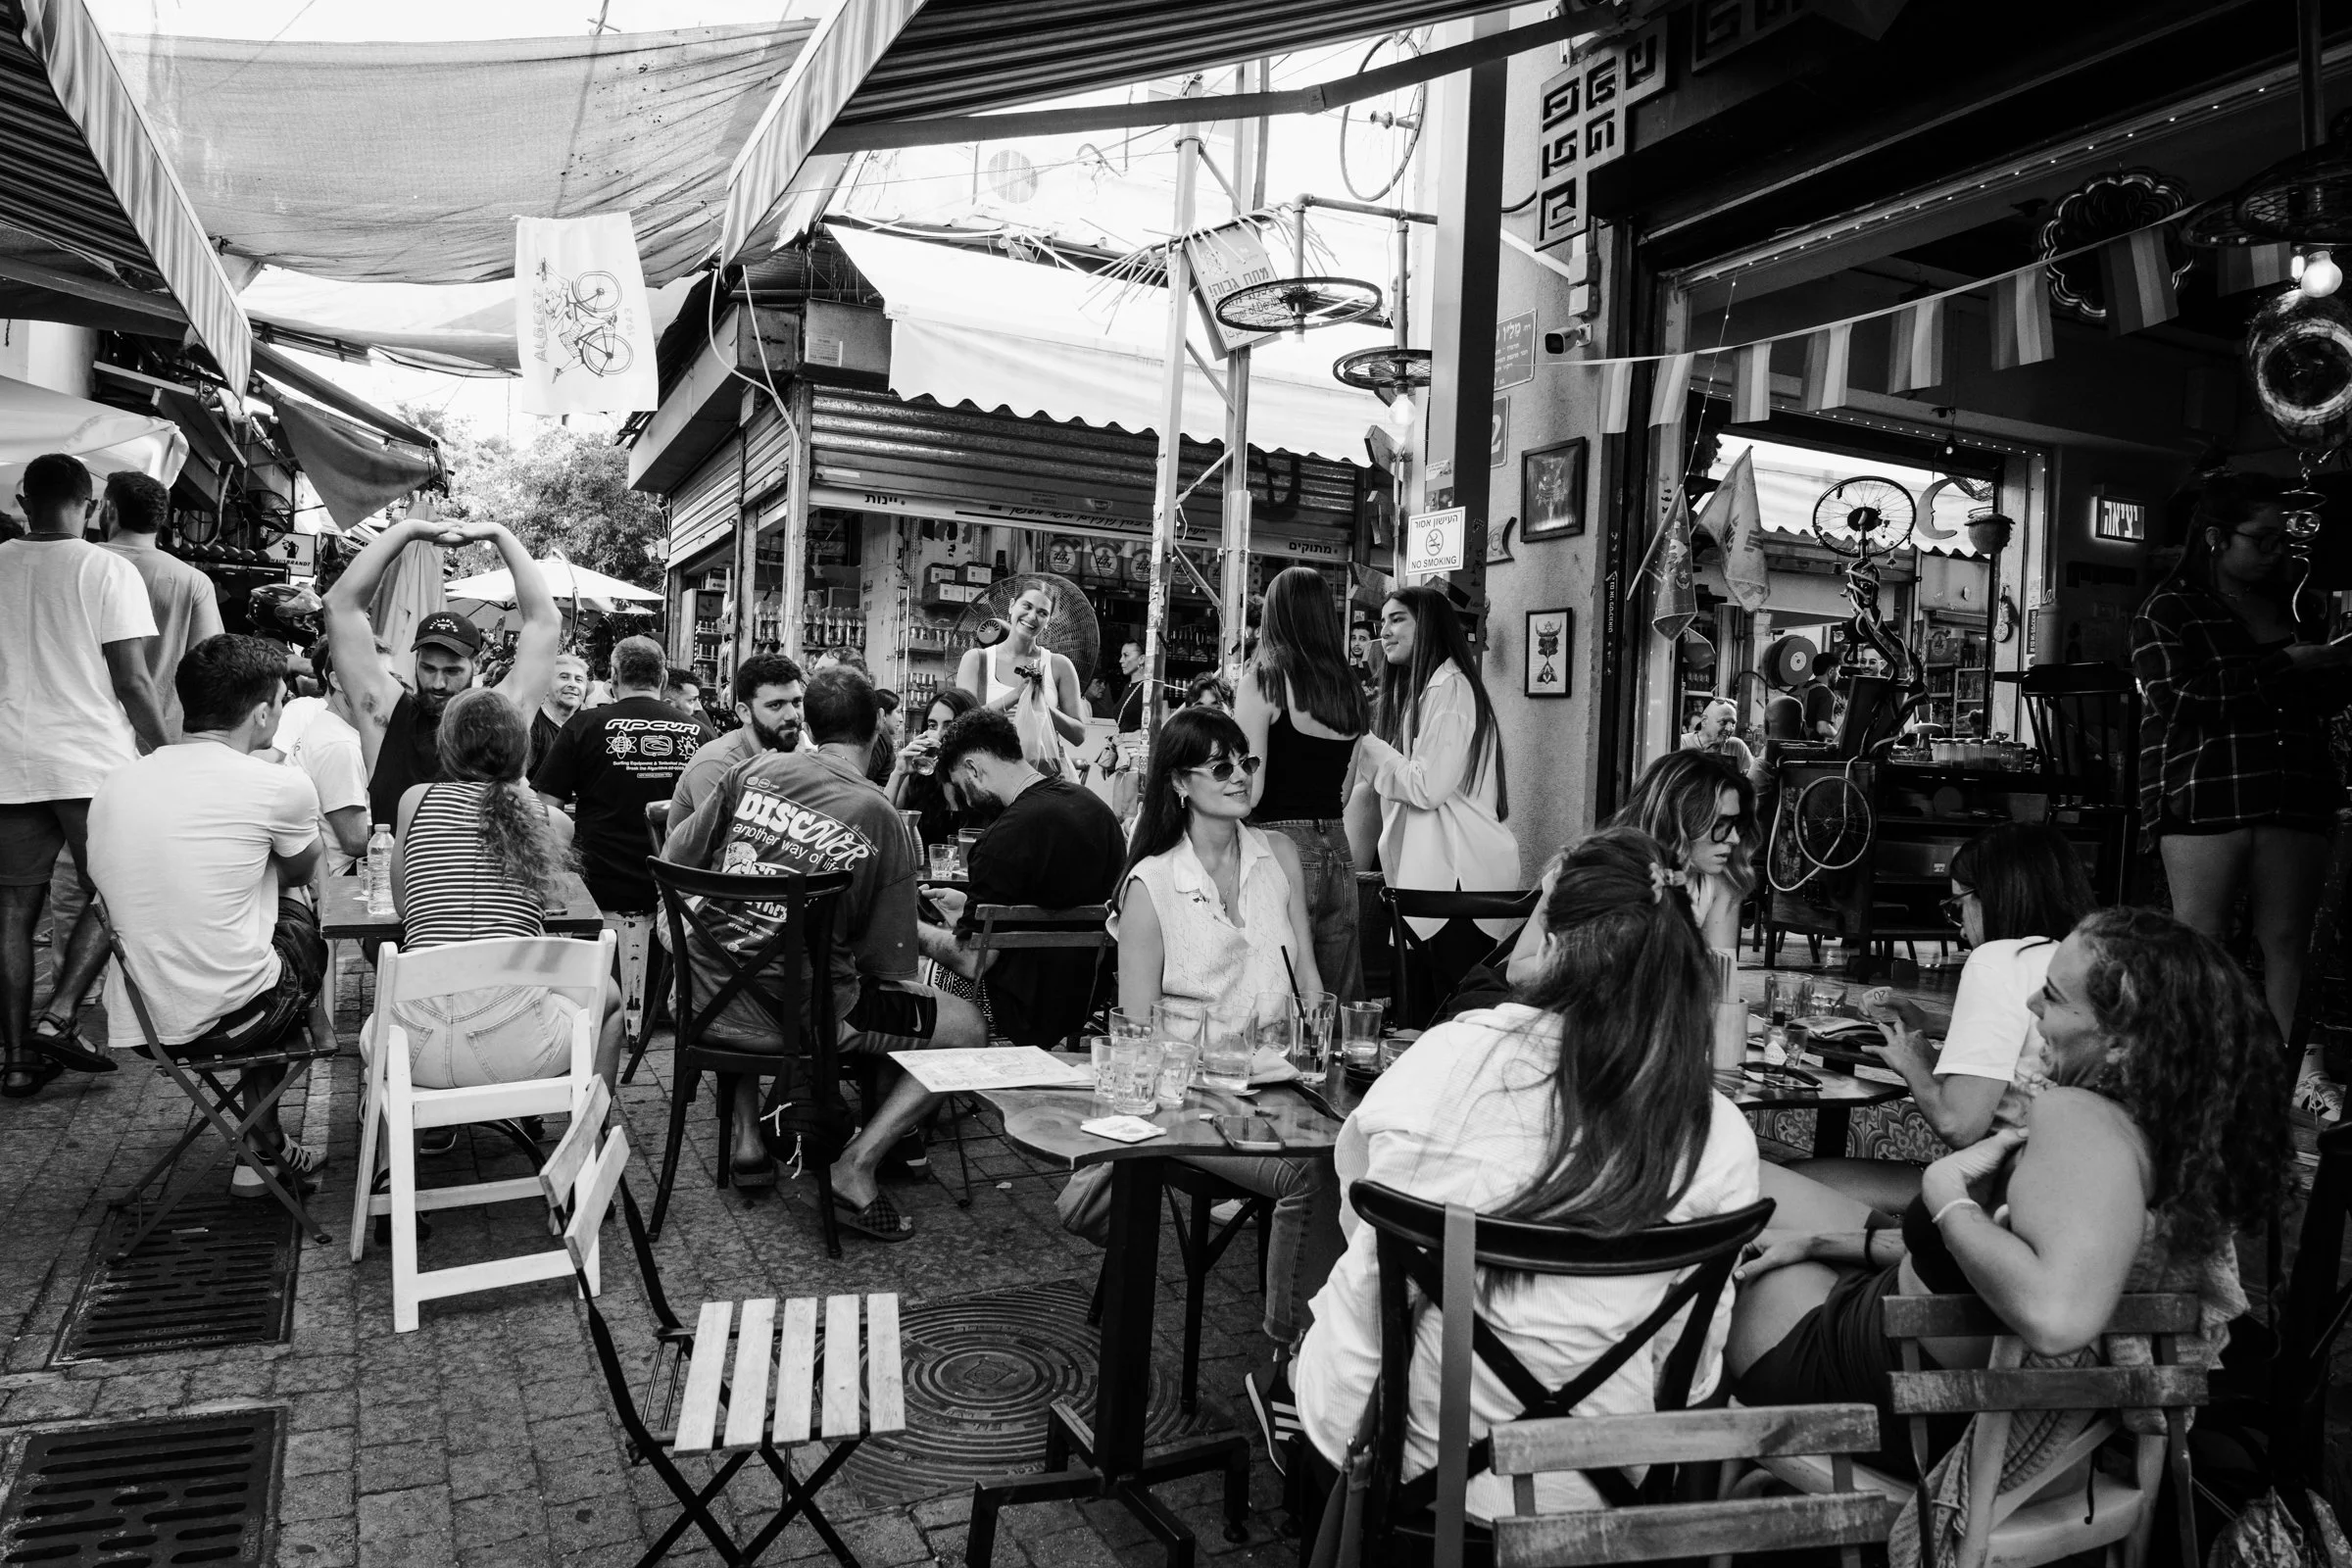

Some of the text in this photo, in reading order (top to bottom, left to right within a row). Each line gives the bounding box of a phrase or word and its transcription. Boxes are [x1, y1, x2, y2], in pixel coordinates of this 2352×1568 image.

[1243, 267, 1269, 285] מתח
[1207, 277, 1241, 297] גבוה!
[864, 493, 898, 505] יינות
[1414, 514, 1458, 528] העישון אסור
[2103, 501, 2137, 538] יציאה
[1289, 541, 1332, 555] מתוקים
[1412, 556, 1457, 568] NO SMOKING
[734, 791, 869, 870] DISCOVER
[732, 822, 780, 847] another
[781, 841, 808, 859] way
[809, 849, 825, 864] of
